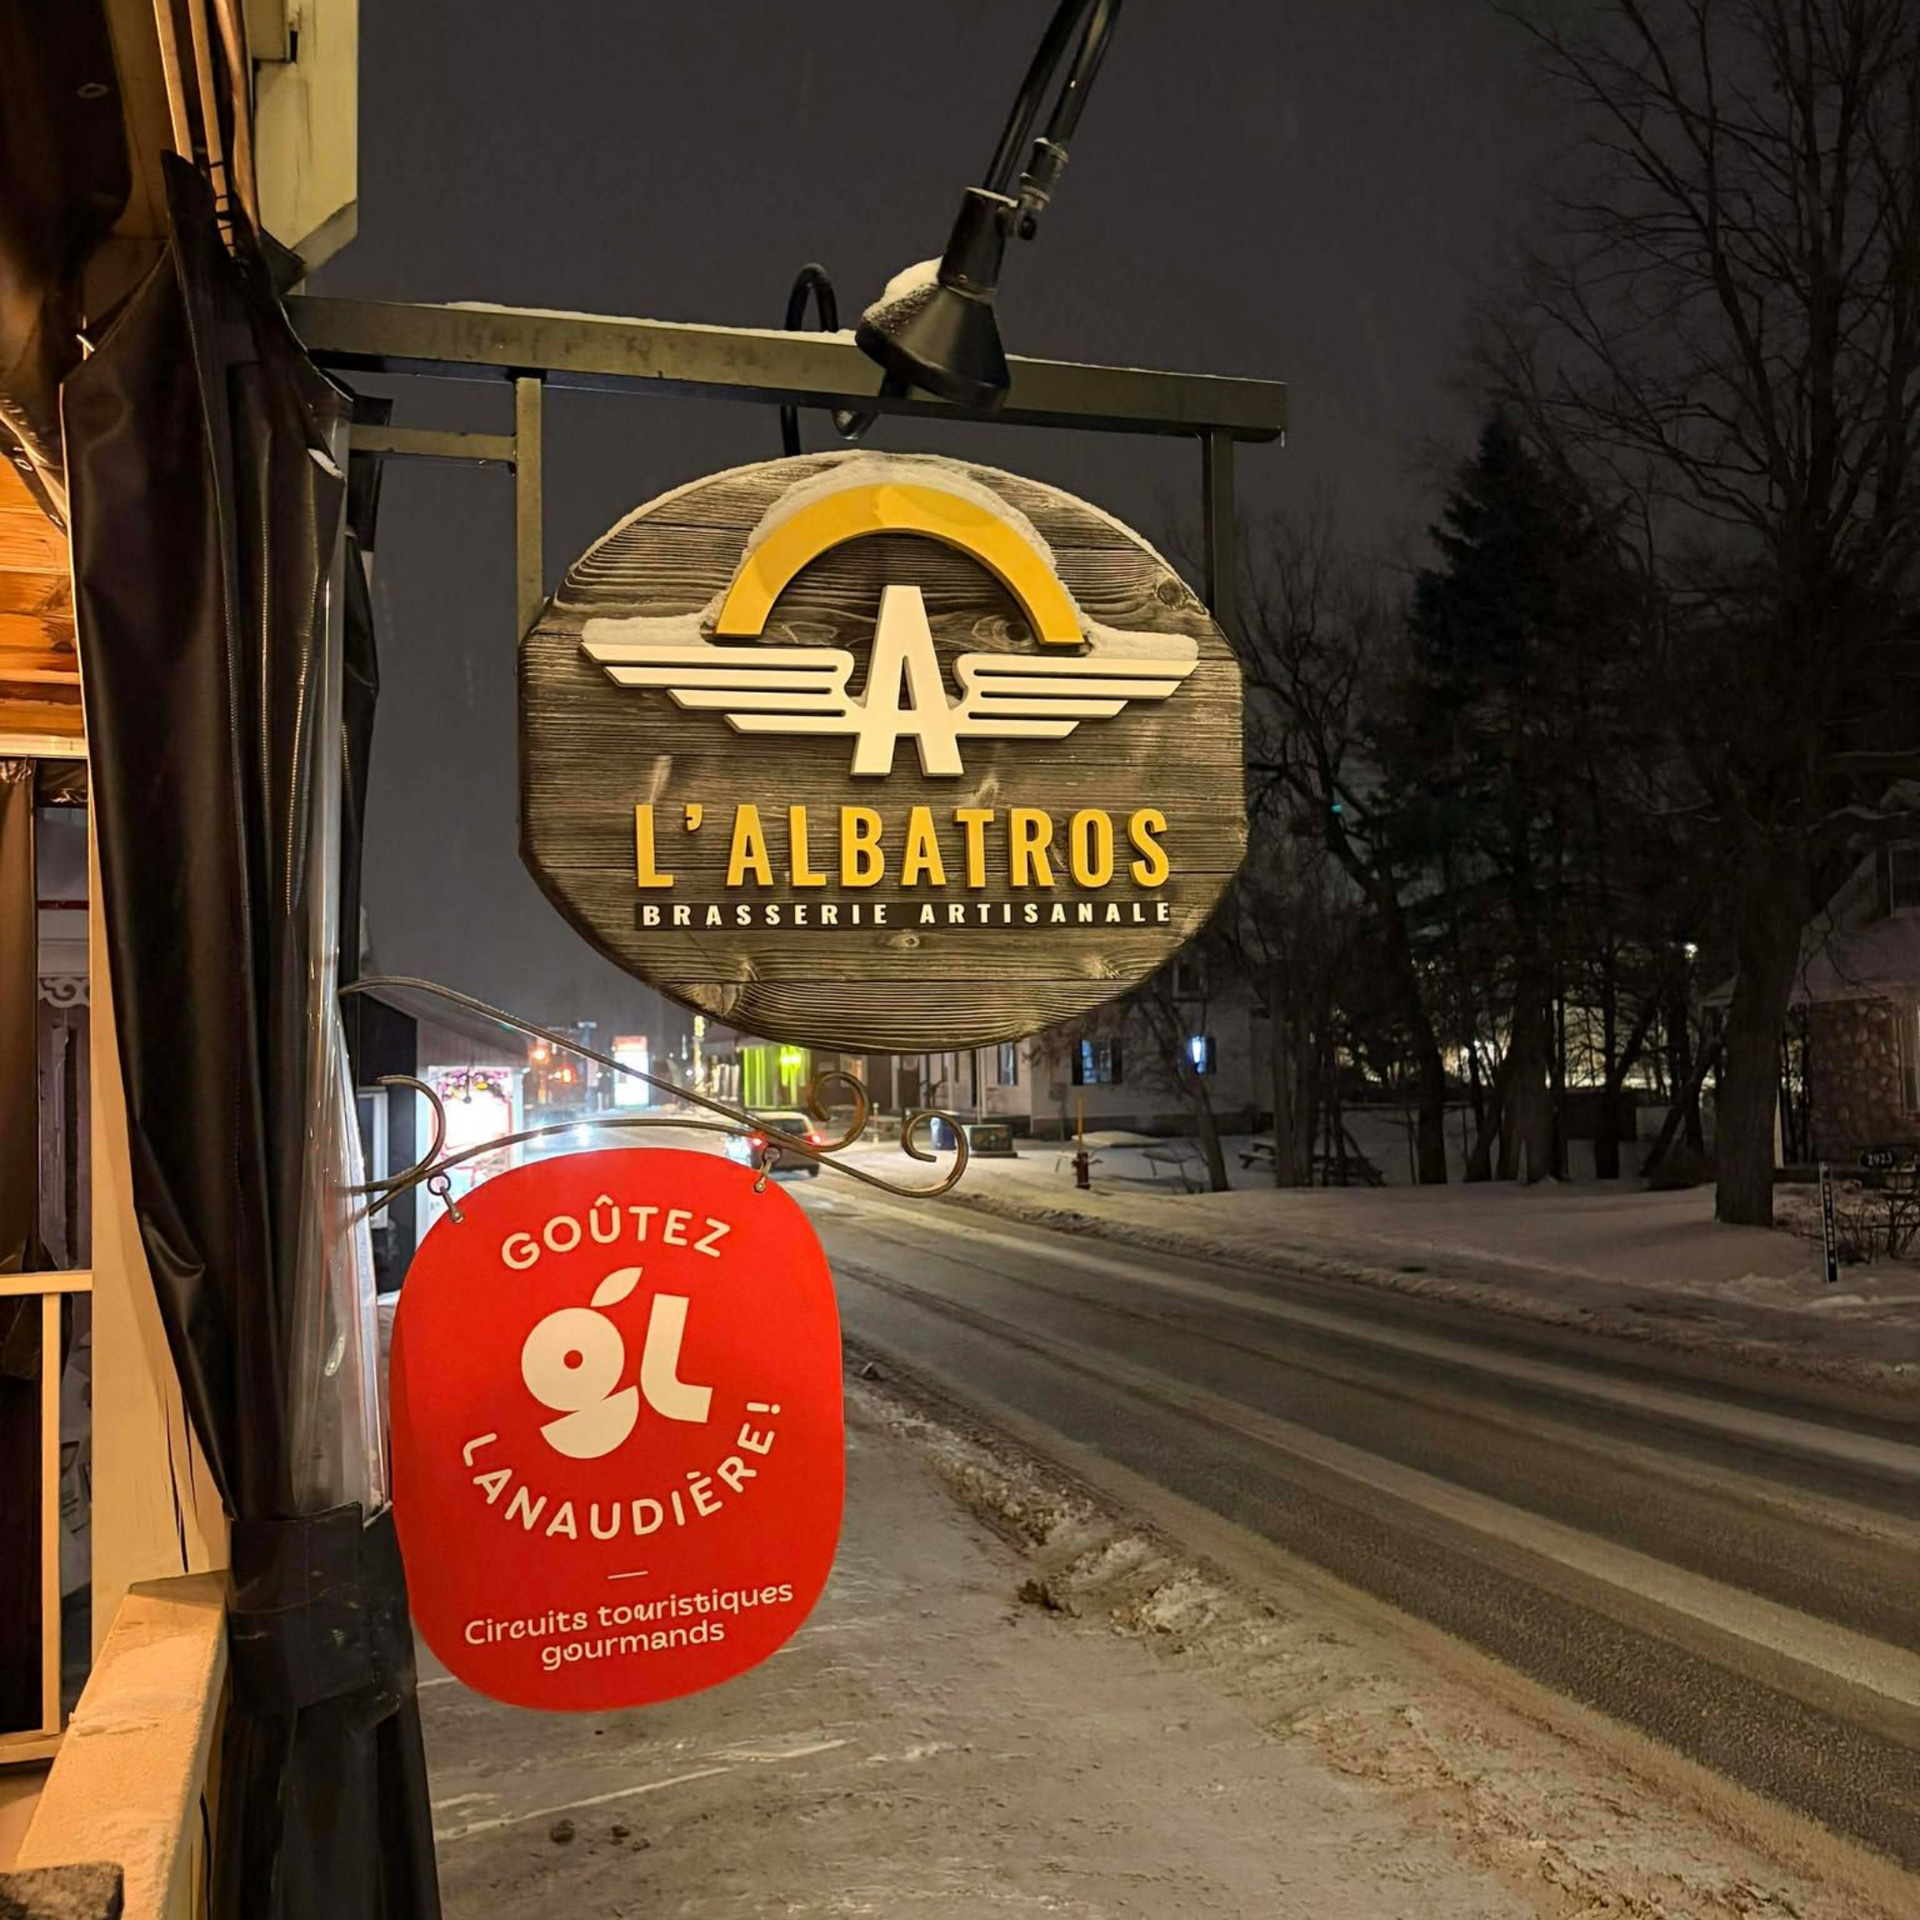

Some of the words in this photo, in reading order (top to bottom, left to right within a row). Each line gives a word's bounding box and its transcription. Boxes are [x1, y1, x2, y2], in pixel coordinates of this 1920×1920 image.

[635, 803, 1171, 888] L'ALBATROS
[642, 903, 889, 927] BRASSERIE
[918, 901, 1172, 925] ARTISANALE
[501, 1193, 732, 1270] GOÛTEZ
[462, 1401, 782, 1541] LANAUDIÈRE!
[464, 1611, 589, 1645] Circuits
[597, 1583, 794, 1627] touristiques
[541, 1619, 726, 1671] gourmands
